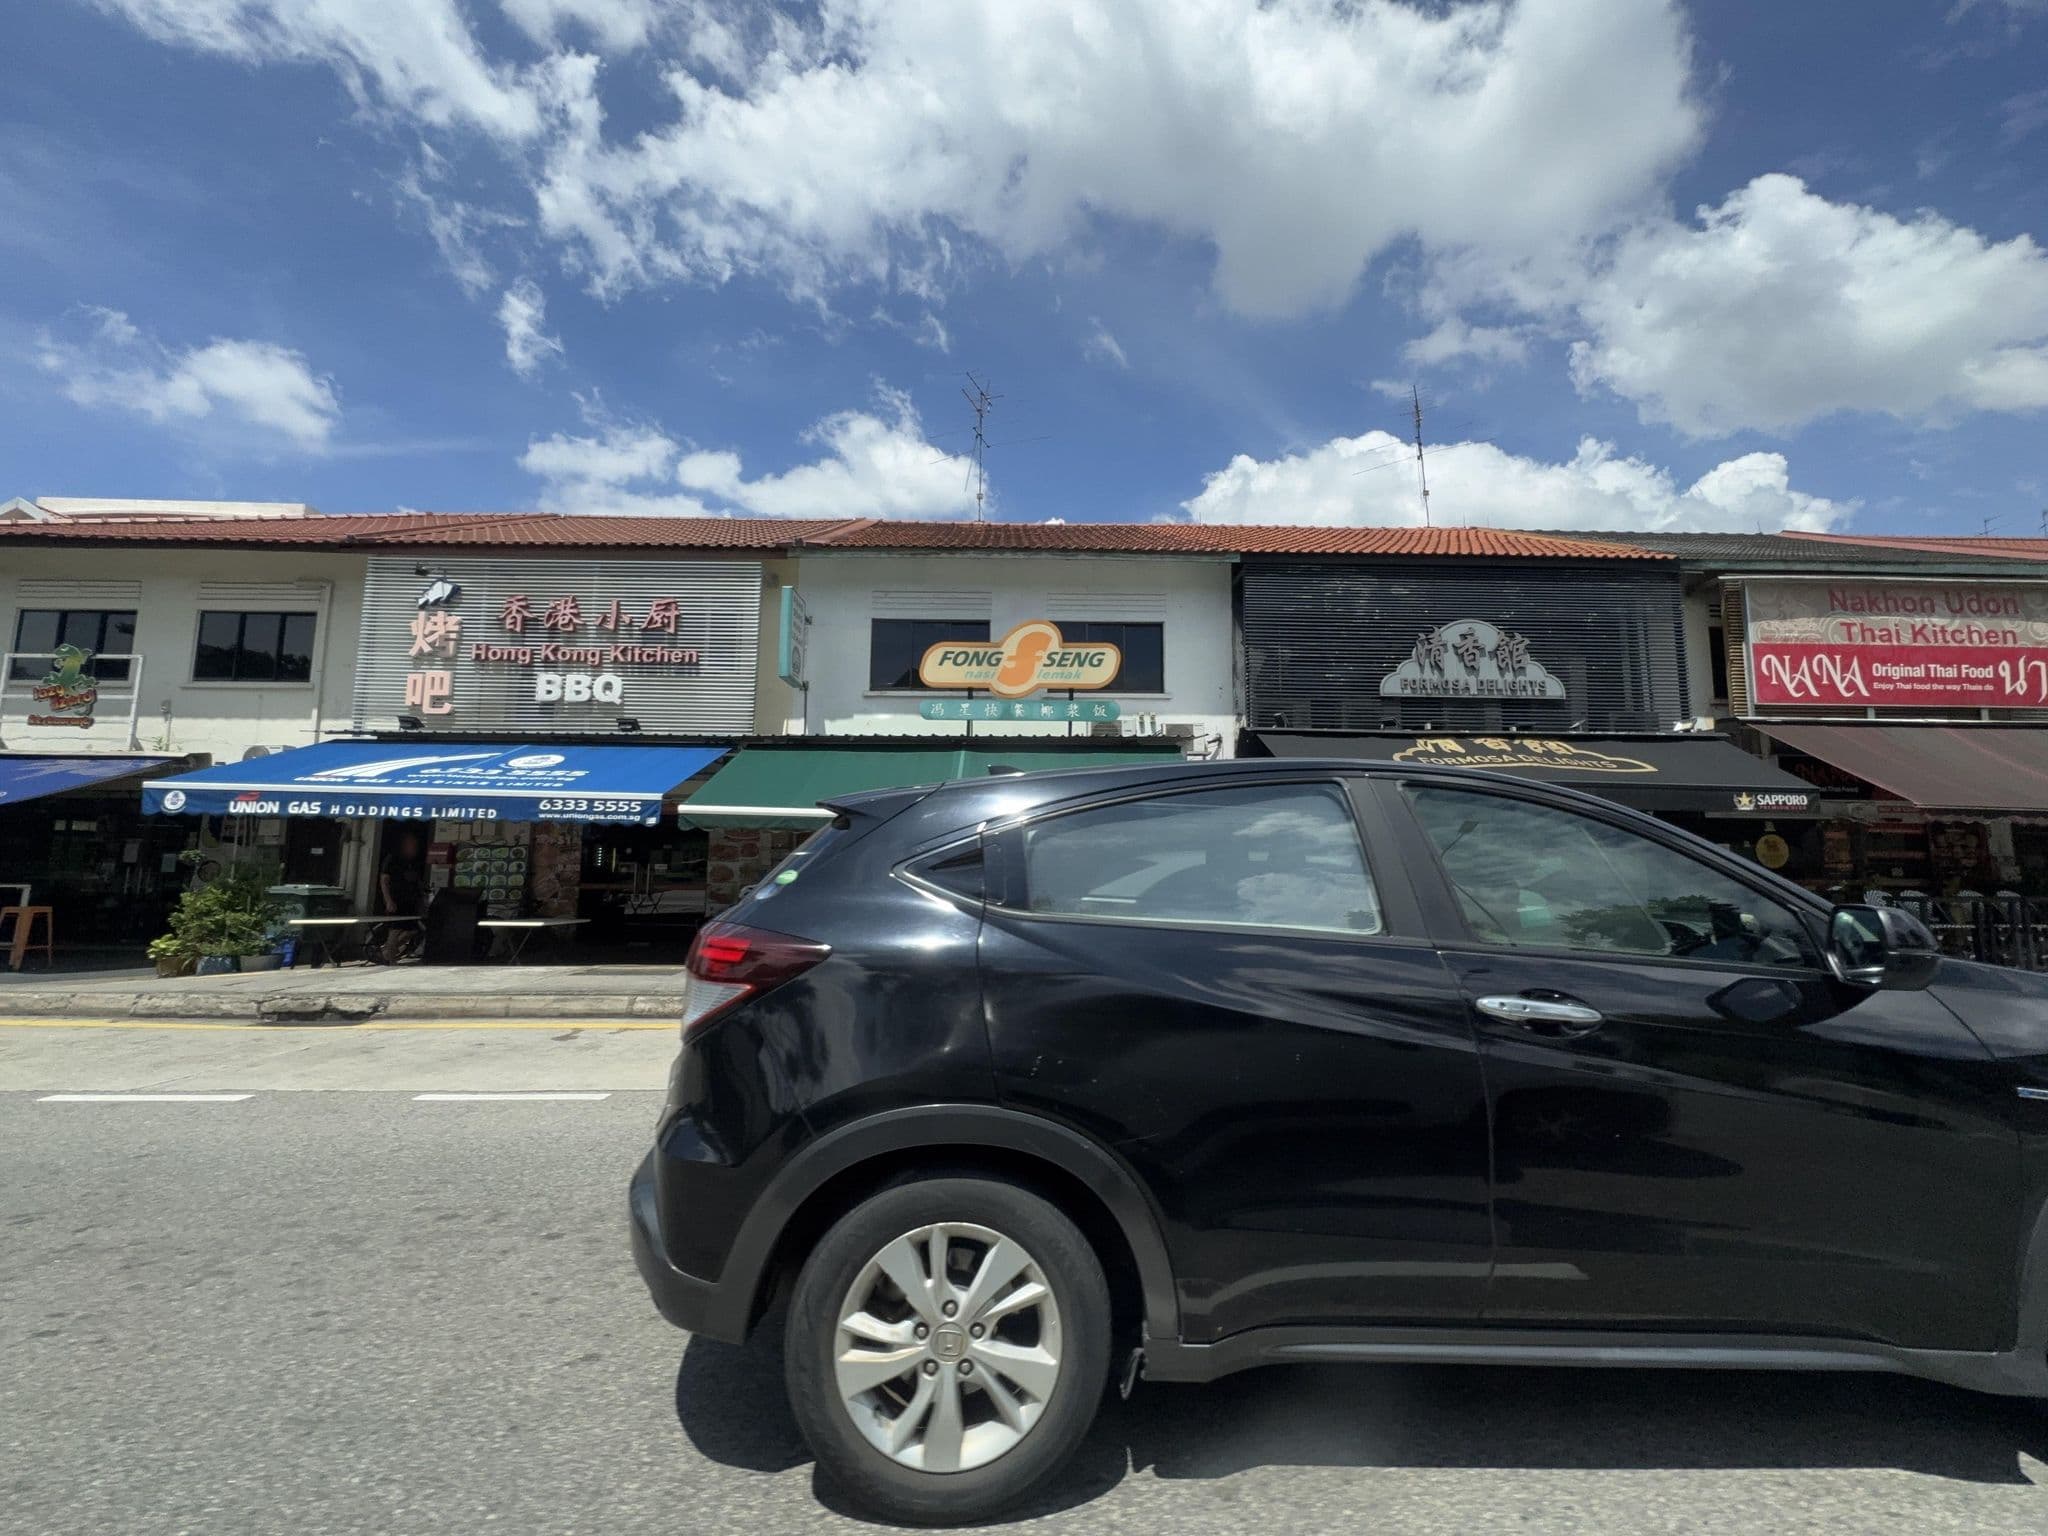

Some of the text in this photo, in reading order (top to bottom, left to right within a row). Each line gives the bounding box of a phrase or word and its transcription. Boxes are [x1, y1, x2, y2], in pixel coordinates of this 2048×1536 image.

[1828, 589, 2020, 615] Nakhon Udon
[499, 594, 681, 634] 香港小厨
[1840, 621, 2019, 645] Thai Kitchen
[470, 643, 699, 666] Hong Kong Kitchen
[1415, 626, 1530, 670] 清香館
[405, 609, 462, 715] 烤吧
[938, 650, 1105, 667] FONG SENG
[964, 669, 995, 680] nasi
[1760, 653, 1870, 698] NANA
[1872, 663, 1994, 679] Original Thai Food
[535, 673, 624, 705] BBQ
[1401, 678, 1547, 692] FORMOSA DELIGHTS
[1873, 682, 1894, 691] Enjoy
[1896, 682, 1912, 690] Thai
[1945, 684, 1961, 692] way
[1418, 754, 1618, 769] FORMOSA DELIGHTS
[538, 799, 642, 812] 6333 5555
[1757, 794, 1808, 806] SAPPORO
[228, 801, 498, 819] UNION GAS HOLDINGS LIMITED
[538, 812, 641, 821] www.uniongas.com.sg
